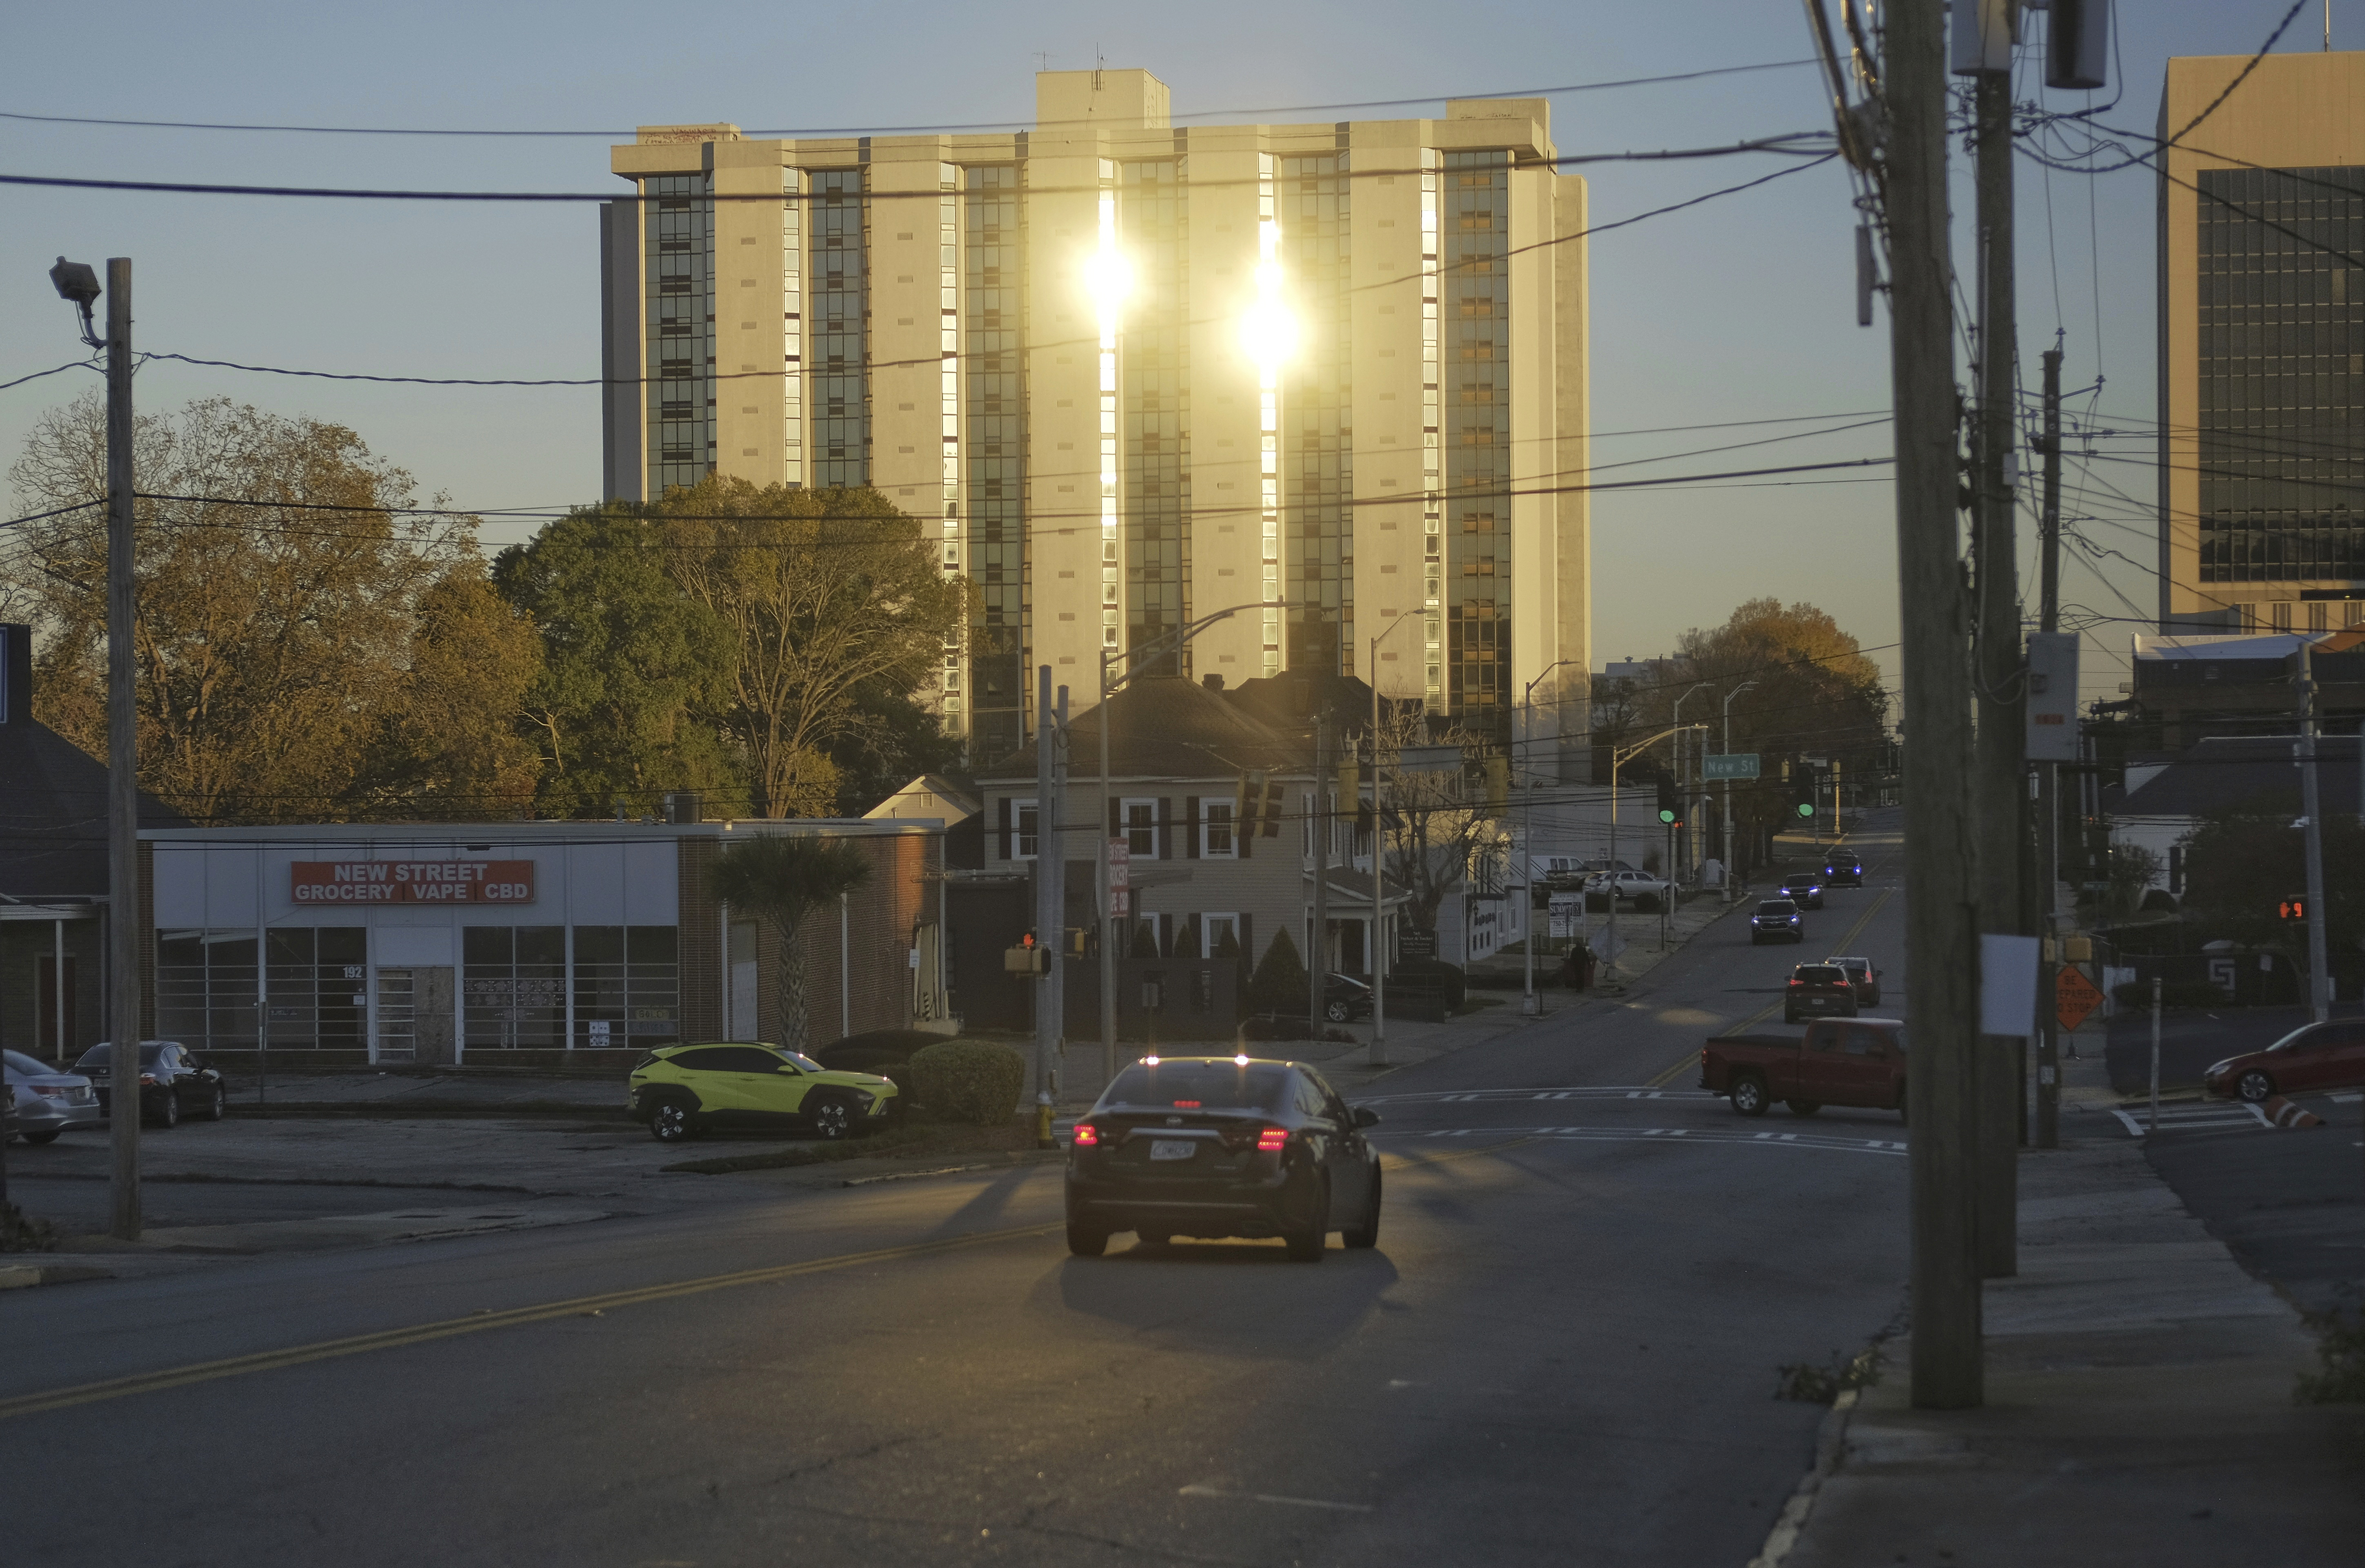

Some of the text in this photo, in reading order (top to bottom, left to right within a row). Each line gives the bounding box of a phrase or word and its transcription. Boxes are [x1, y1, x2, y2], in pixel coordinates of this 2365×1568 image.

[1708, 760, 1754, 773] New St
[334, 864, 487, 882] NEW STREET
[1110, 864, 1128, 886] ROCERY
[295, 883, 527, 900] GROCERY VAPE CBD
[2293, 902, 2302, 917] 9
[343, 966, 362, 979] 192
[2064, 976, 2076, 985] BE
[2059, 989, 2097, 999] EPARED
[2068, 1003, 2091, 1013] STOP
